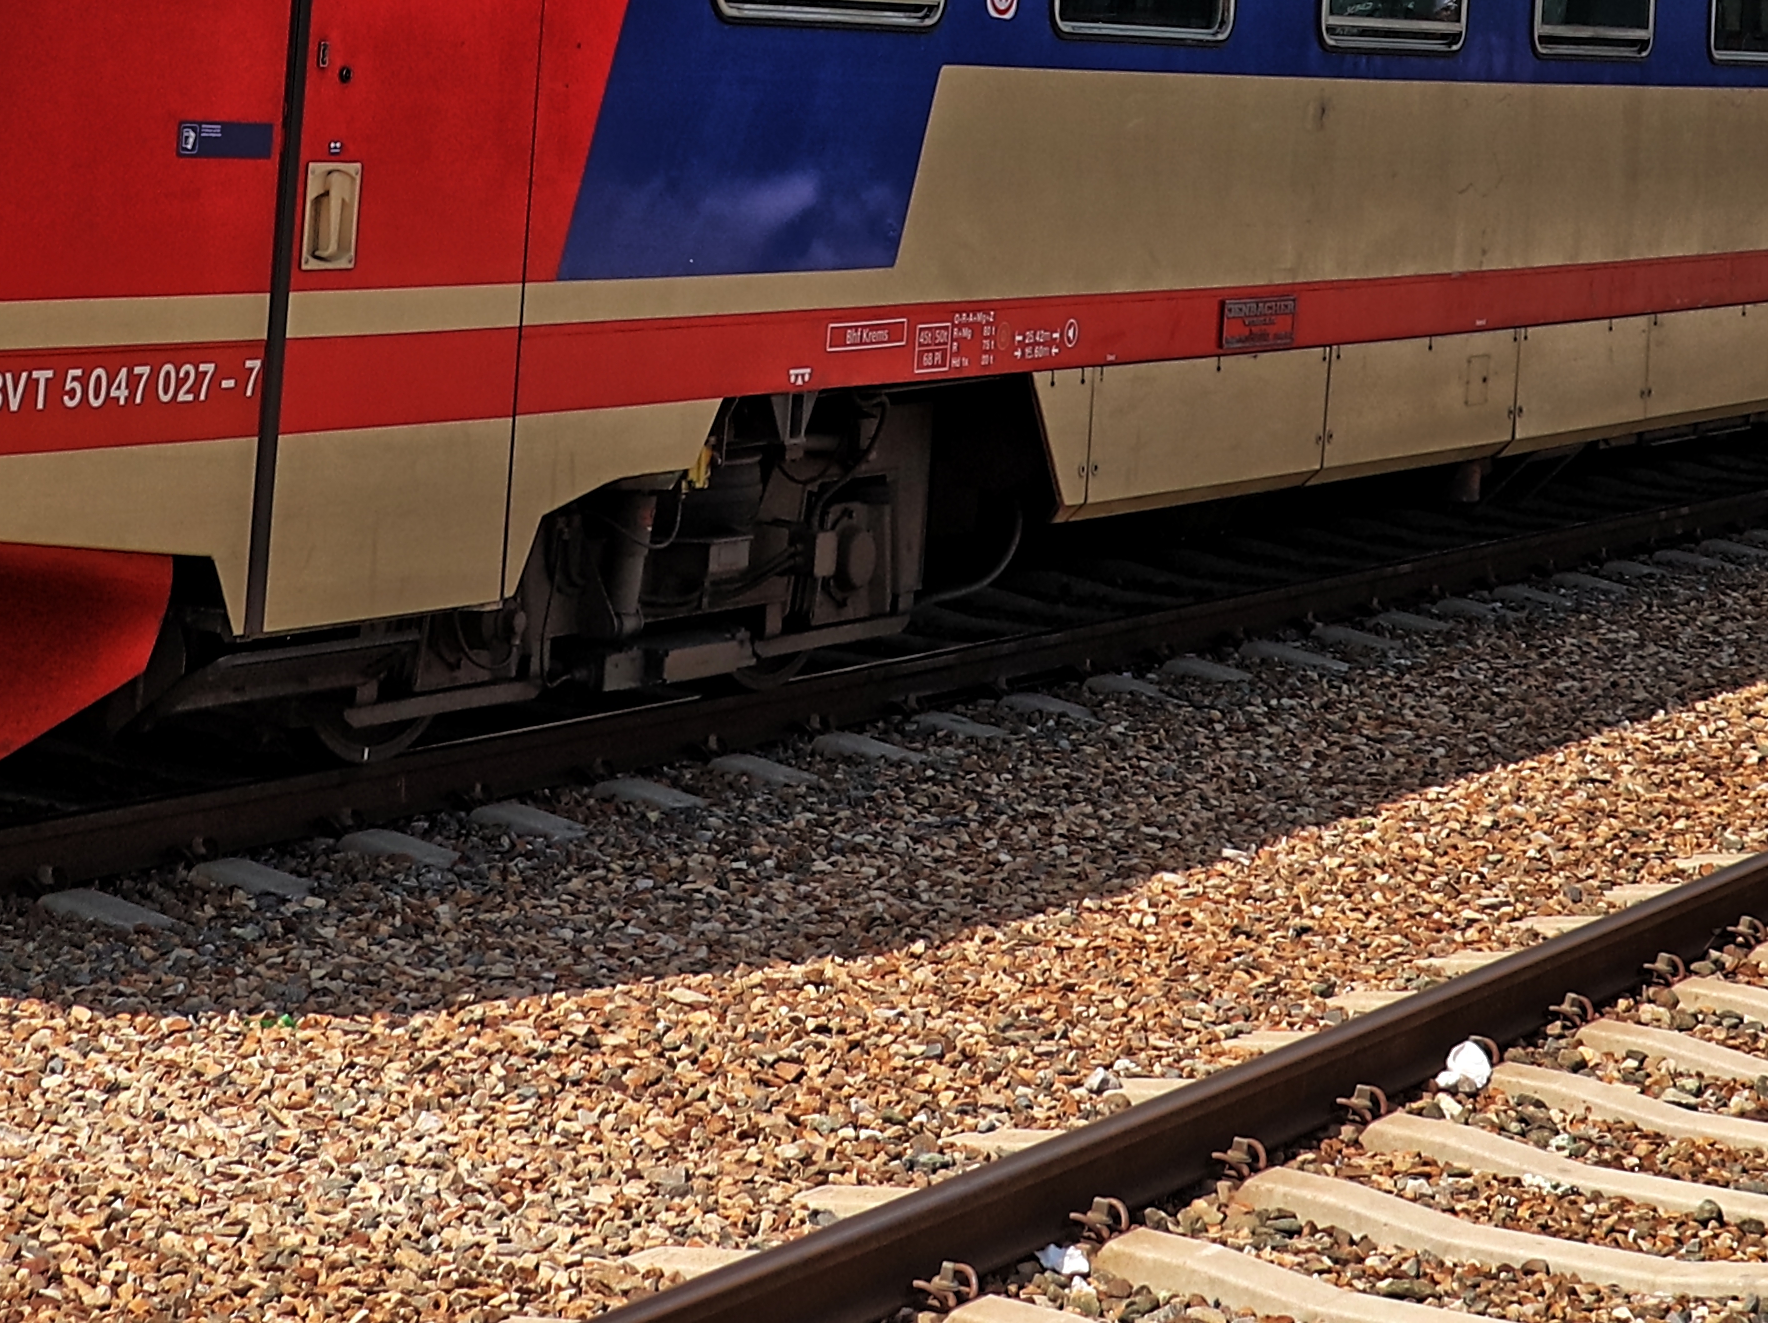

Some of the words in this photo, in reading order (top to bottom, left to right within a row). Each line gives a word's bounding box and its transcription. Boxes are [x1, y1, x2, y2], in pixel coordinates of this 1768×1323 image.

[845, 327, 862, 345] Bhf
[862, 328, 889, 344] Krems
[62, 364, 151, 409] 5047
